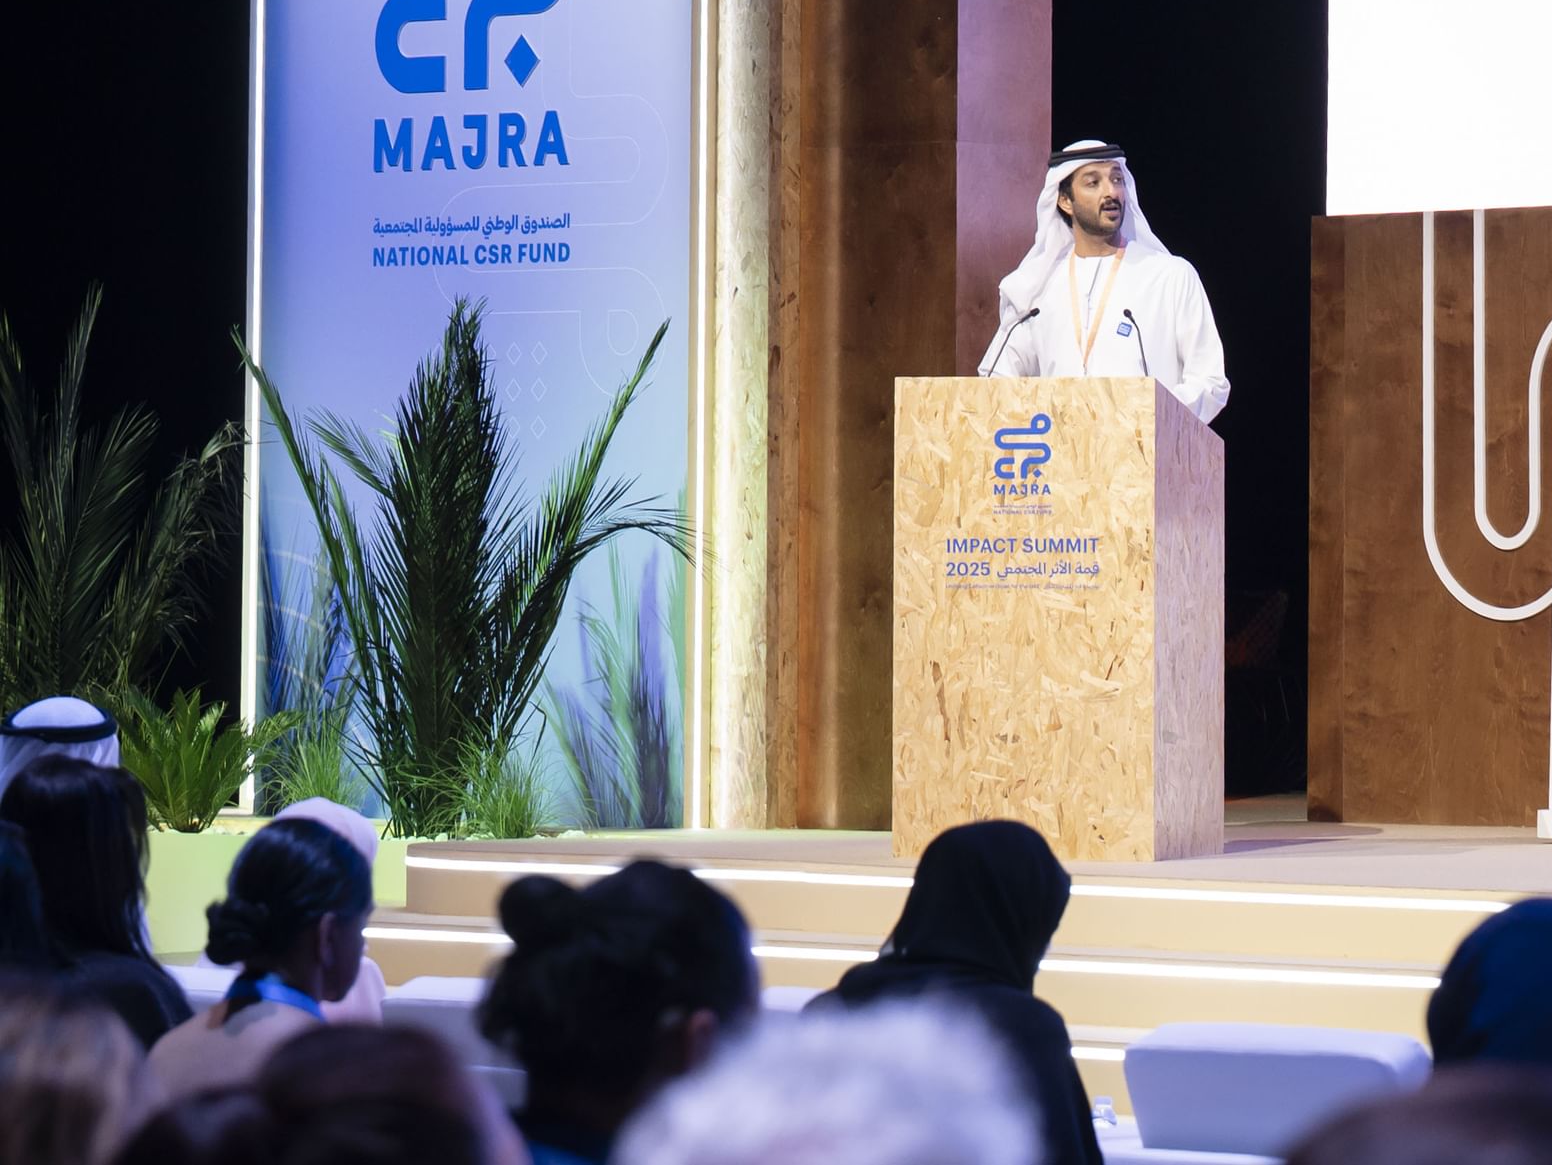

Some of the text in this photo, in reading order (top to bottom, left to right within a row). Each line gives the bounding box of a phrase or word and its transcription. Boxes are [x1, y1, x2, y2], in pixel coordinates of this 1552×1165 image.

[373, 110, 570, 173] MAJRA
[373, 213, 571, 240] الصندوق الوطني للمسؤولية المجتمعية
[373, 243, 570, 267] NATIONAL CSR FUND
[994, 484, 1051, 495] MAJRA
[946, 538, 1099, 553] IMPACT SUMMIT
[946, 562, 990, 577] 2025
[997, 560, 1100, 581] قمة الأثر المجتمعي
